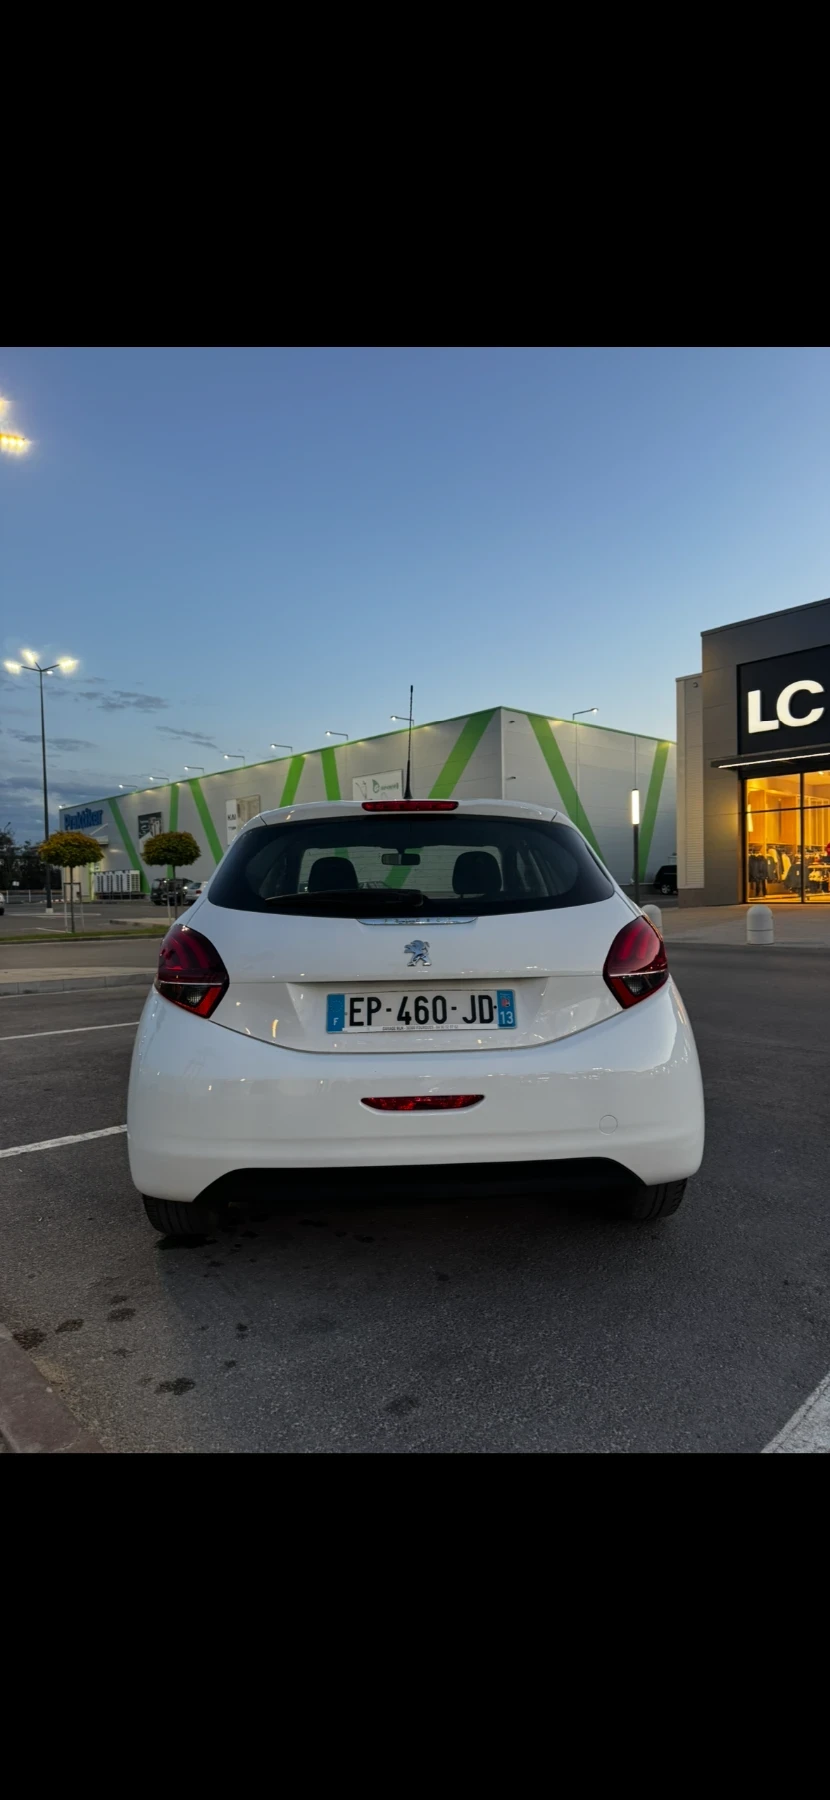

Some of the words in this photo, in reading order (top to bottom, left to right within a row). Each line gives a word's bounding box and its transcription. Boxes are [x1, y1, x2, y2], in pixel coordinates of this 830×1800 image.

[748, 680, 824, 734] LC
[333, 1017, 340, 1026] F
[500, 1011, 514, 1024] 13
